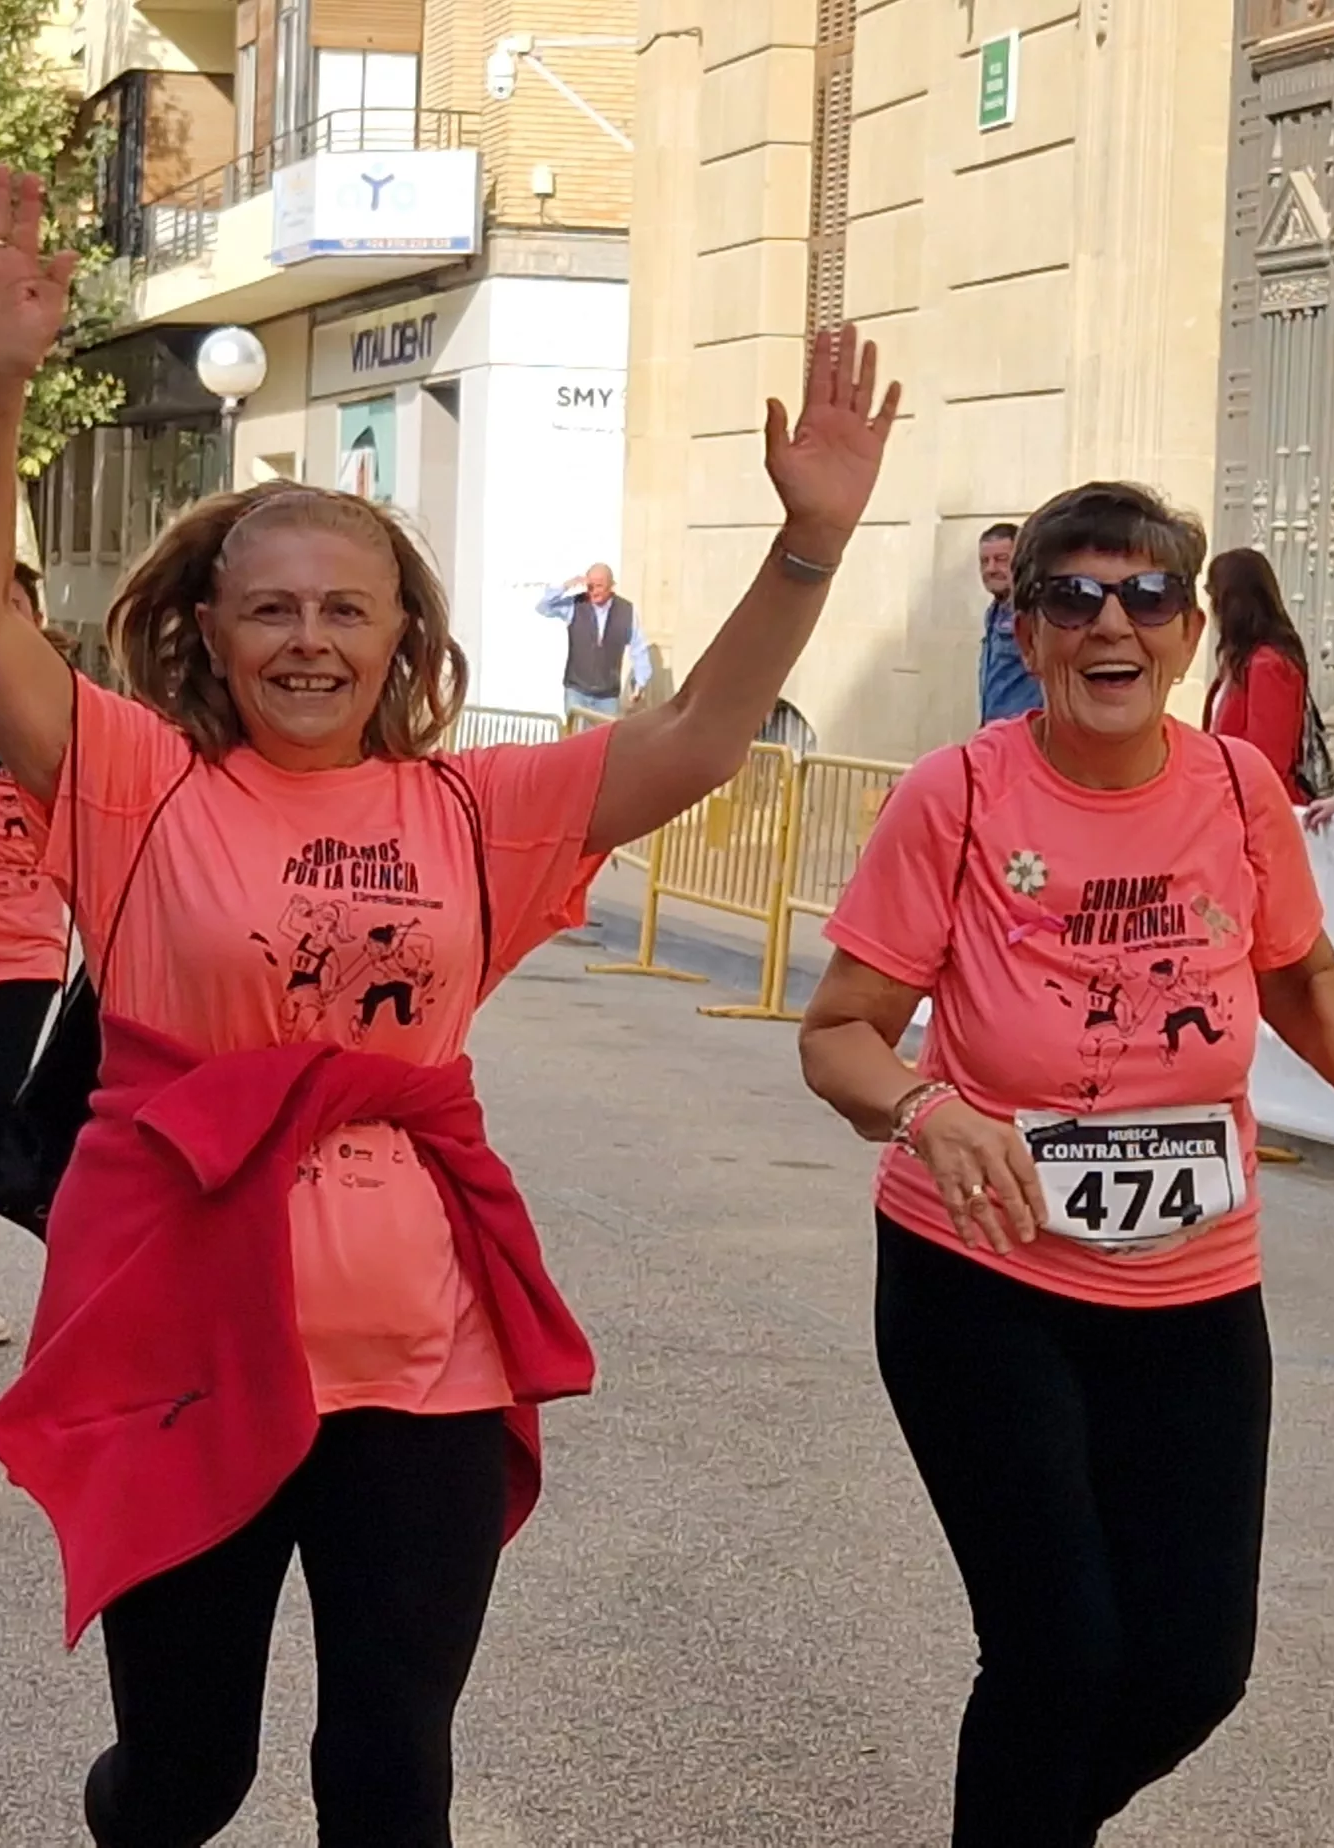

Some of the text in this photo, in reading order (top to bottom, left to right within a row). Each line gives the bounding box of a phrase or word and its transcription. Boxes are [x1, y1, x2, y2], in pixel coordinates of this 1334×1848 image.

[350, 313, 438, 372] VITALDENT
[556, 385, 614, 409] SMY
[301, 837, 401, 867] CORRAMOS
[282, 857, 418, 893] POR LA CIENCIA
[1060, 913, 1095, 946] POR
[1098, 912, 1118, 945] LA
[1123, 903, 1185, 943] CIENCIA
[1042, 1136, 1217, 1160] CONTRA EL CÁNCER
[1107, 1128, 1159, 1142] HUESCA
[1065, 1167, 1203, 1231] 474
